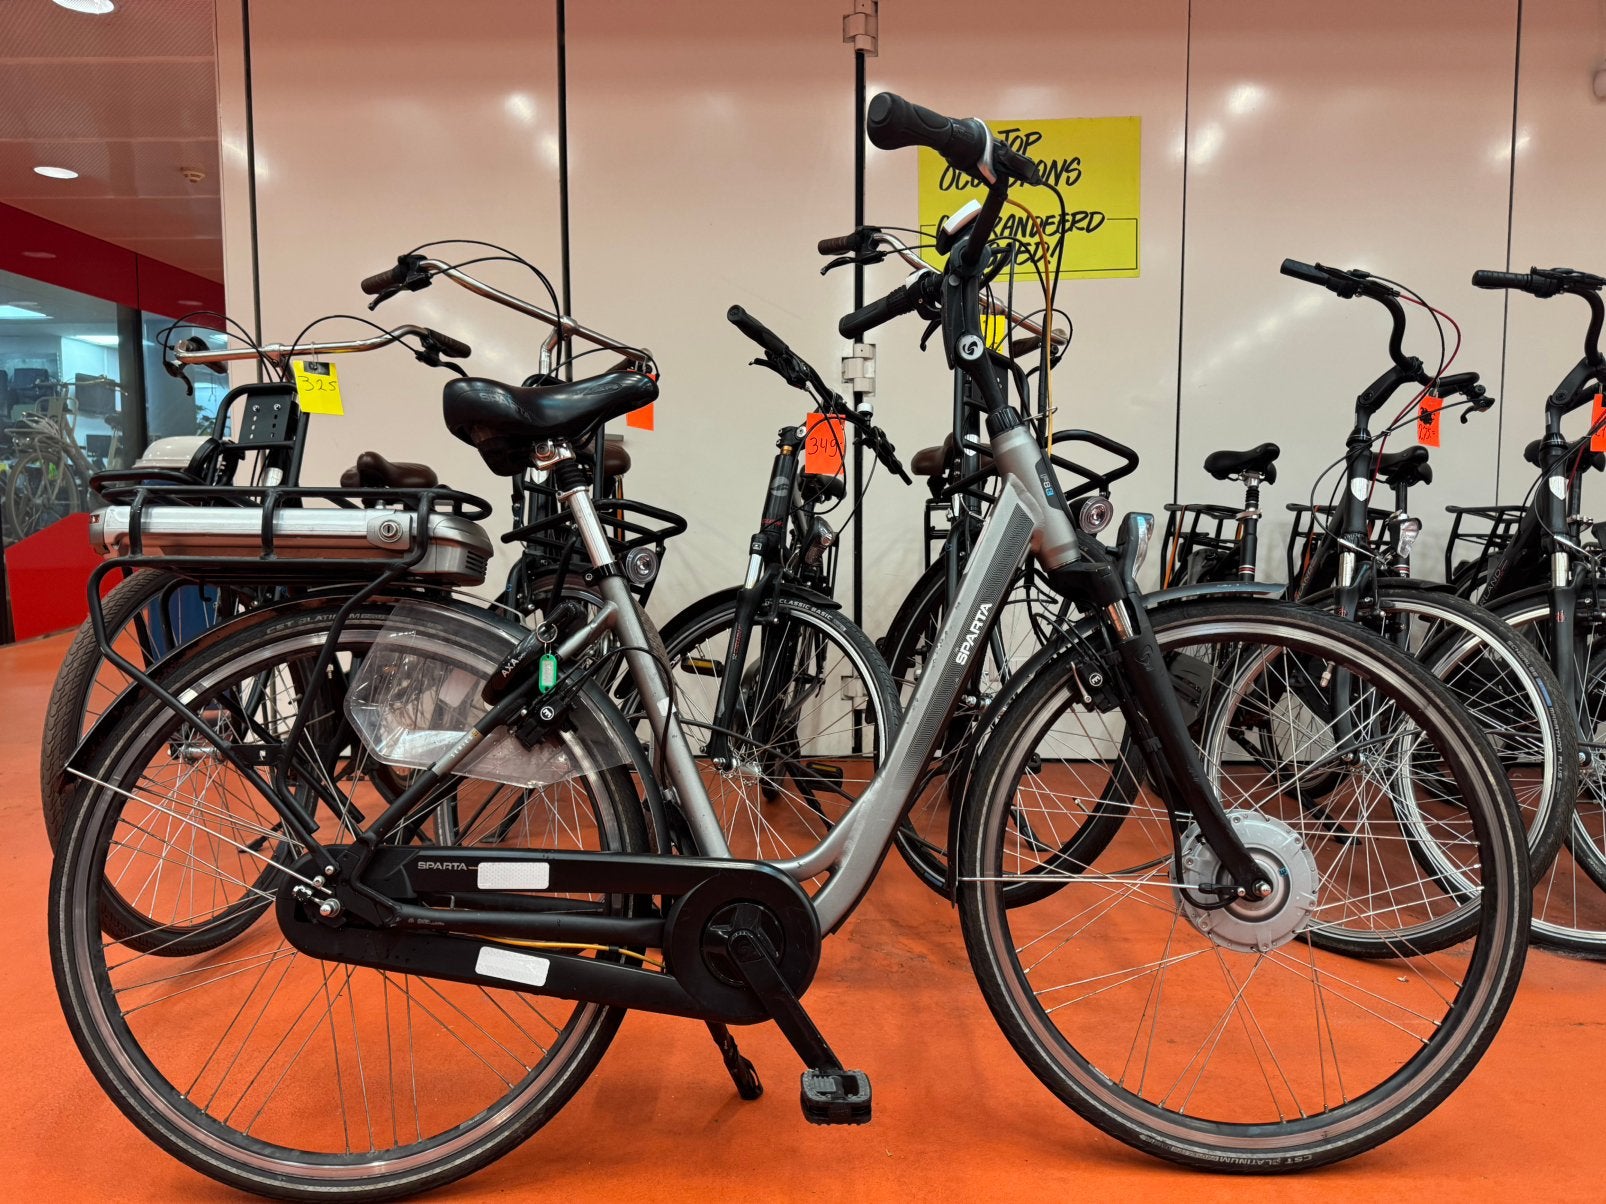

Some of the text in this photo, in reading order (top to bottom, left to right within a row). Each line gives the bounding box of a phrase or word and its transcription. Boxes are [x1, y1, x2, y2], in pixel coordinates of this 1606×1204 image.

[298, 375, 337, 392] 325
[779, 598, 810, 610] CLASSIC
[811, 606, 834, 620] BASIC
[955, 602, 993, 666] SPARTA
[501, 658, 519, 678] AXA
[417, 861, 468, 871] SPARTA
[1284, 1154, 1313, 1165] CST
